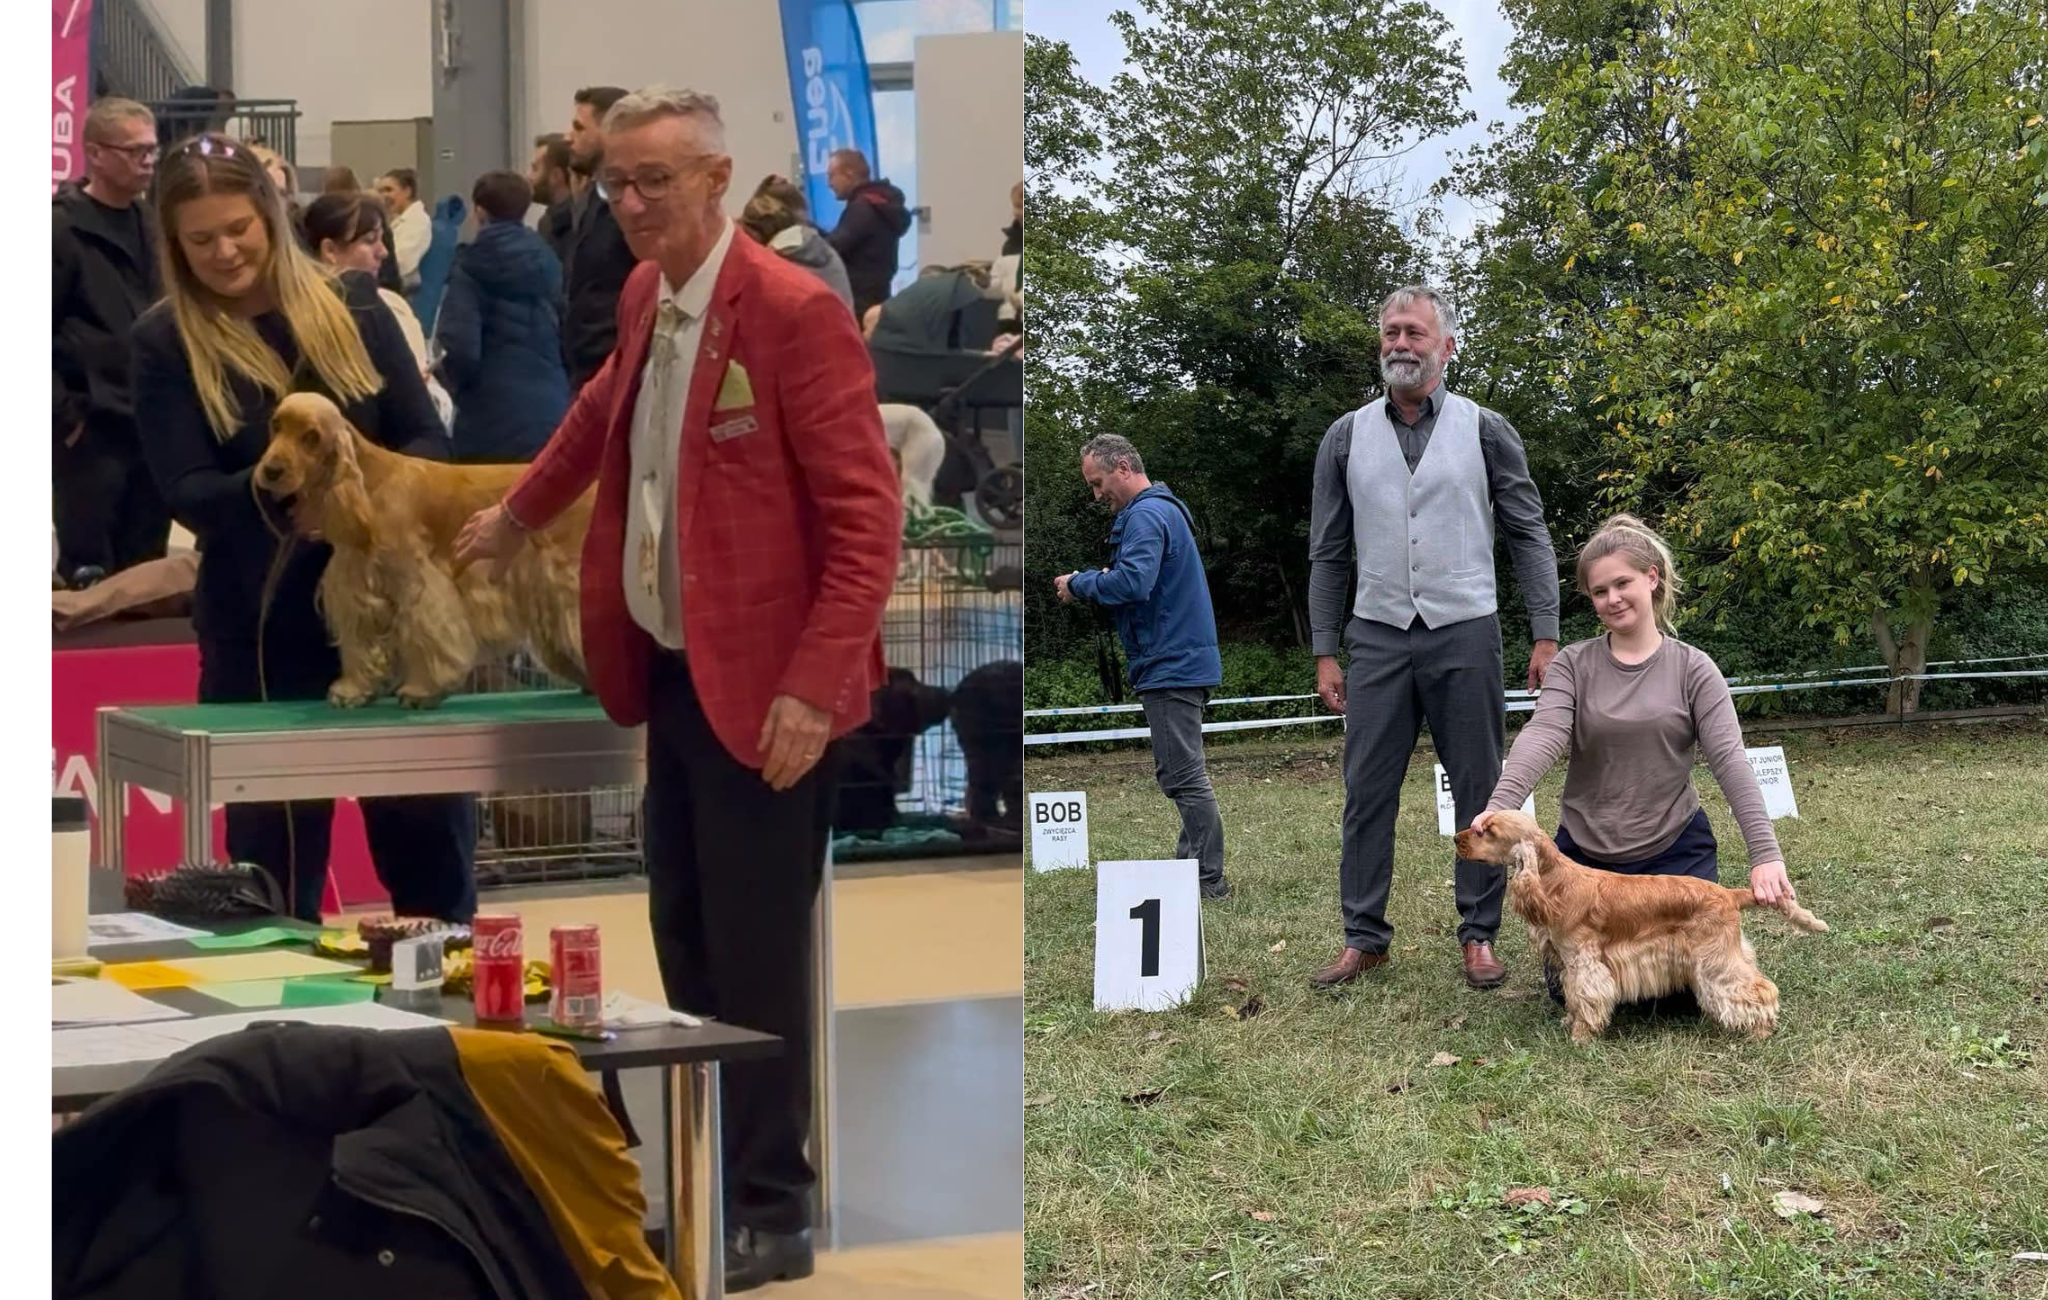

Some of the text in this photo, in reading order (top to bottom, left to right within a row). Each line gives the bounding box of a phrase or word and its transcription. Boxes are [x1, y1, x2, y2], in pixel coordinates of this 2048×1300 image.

[52, 74, 77, 195] UBA
[1759, 754, 1784, 764] JUNIOR
[1035, 801, 1082, 824] BOB
[1129, 898, 1161, 977] 1
